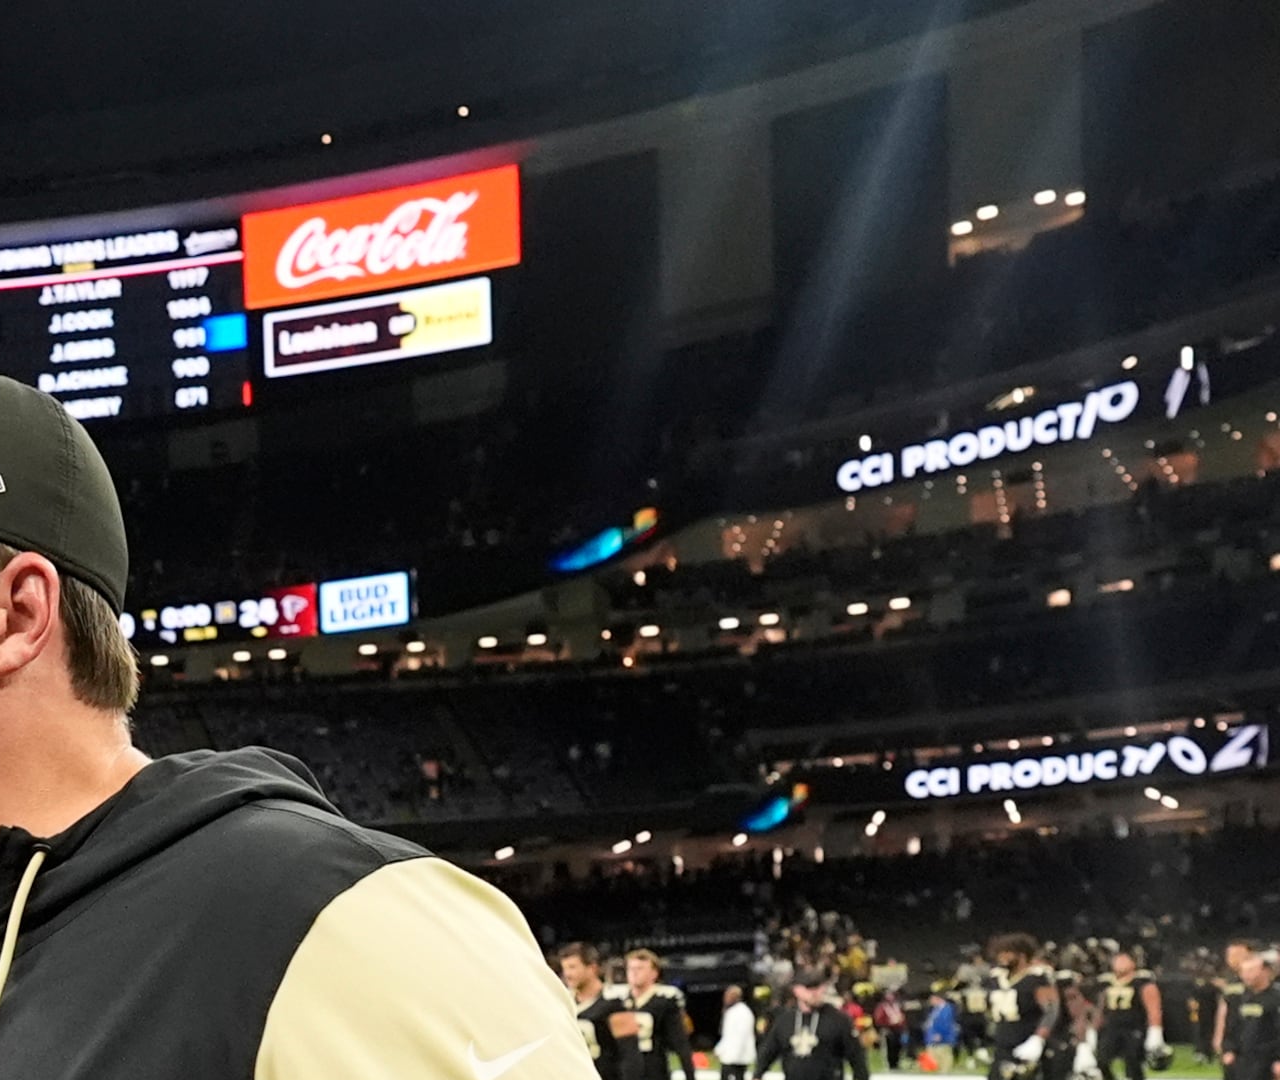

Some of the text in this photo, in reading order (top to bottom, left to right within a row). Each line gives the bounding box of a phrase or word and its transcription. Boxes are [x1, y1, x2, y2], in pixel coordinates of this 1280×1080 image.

[836, 451, 894, 492] CCI
[339, 583, 389, 604] BUD
[239, 597, 279, 628] 24
[329, 600, 398, 624] LIGHT
[904, 767, 961, 799] CCI
